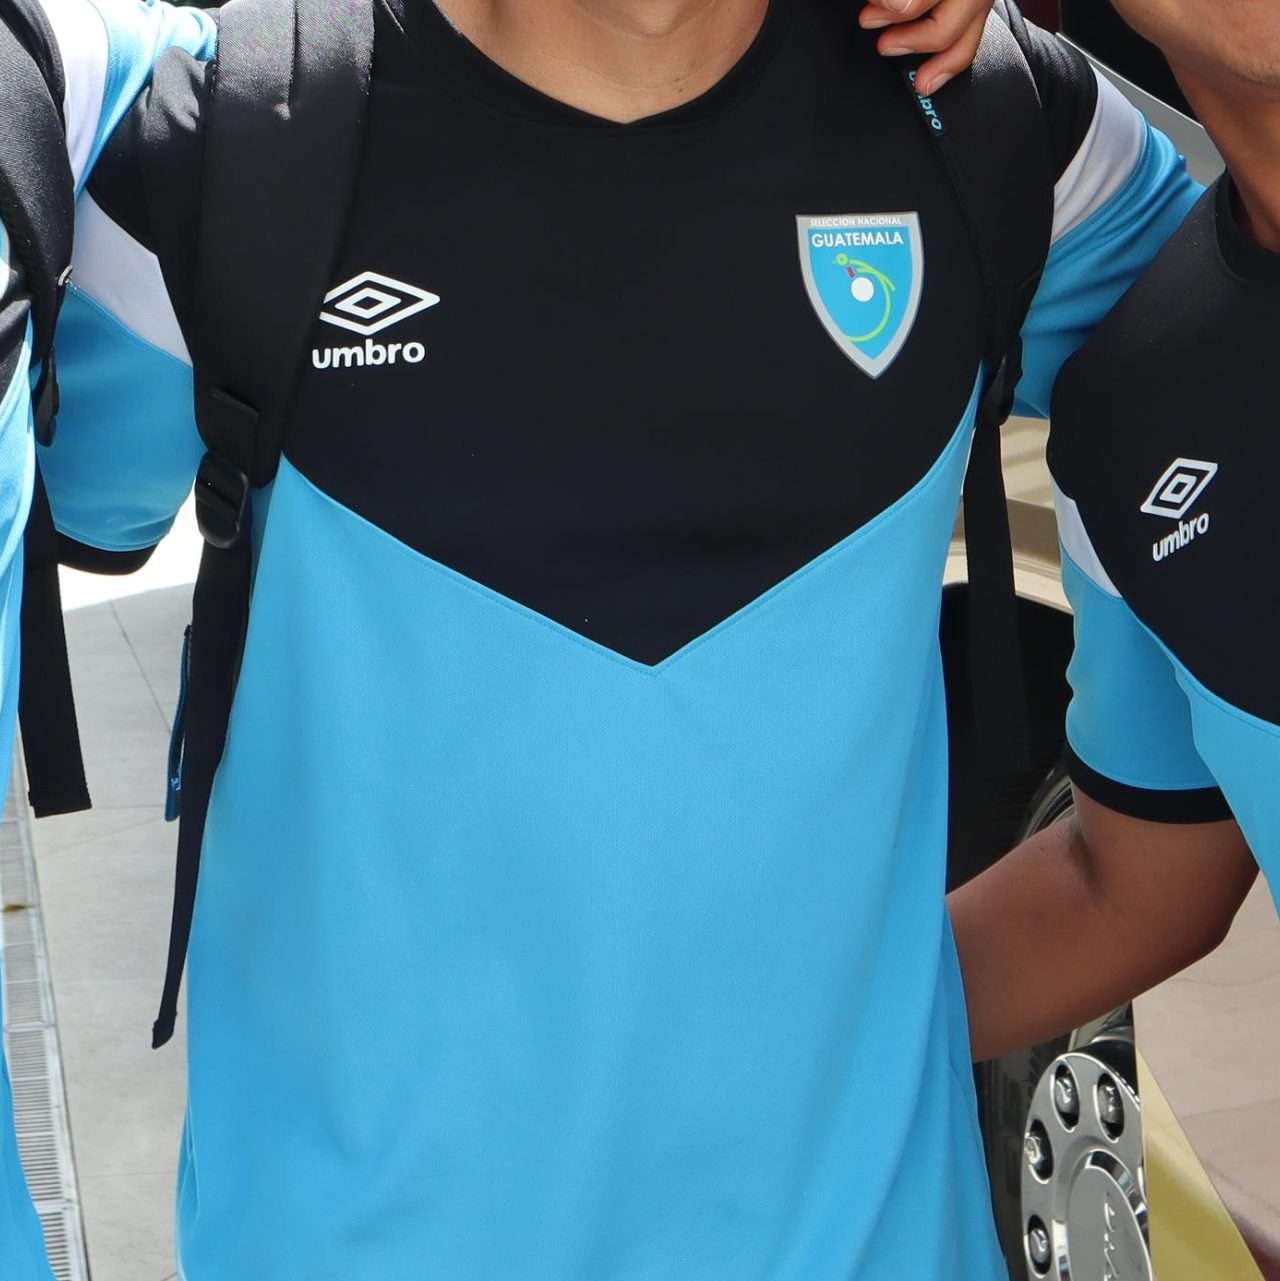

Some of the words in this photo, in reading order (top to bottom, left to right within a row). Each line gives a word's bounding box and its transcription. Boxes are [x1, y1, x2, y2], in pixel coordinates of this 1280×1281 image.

[811, 231, 905, 248] GUATEMALA
[312, 338, 426, 369] umbro
[1152, 512, 1210, 562] umbro
